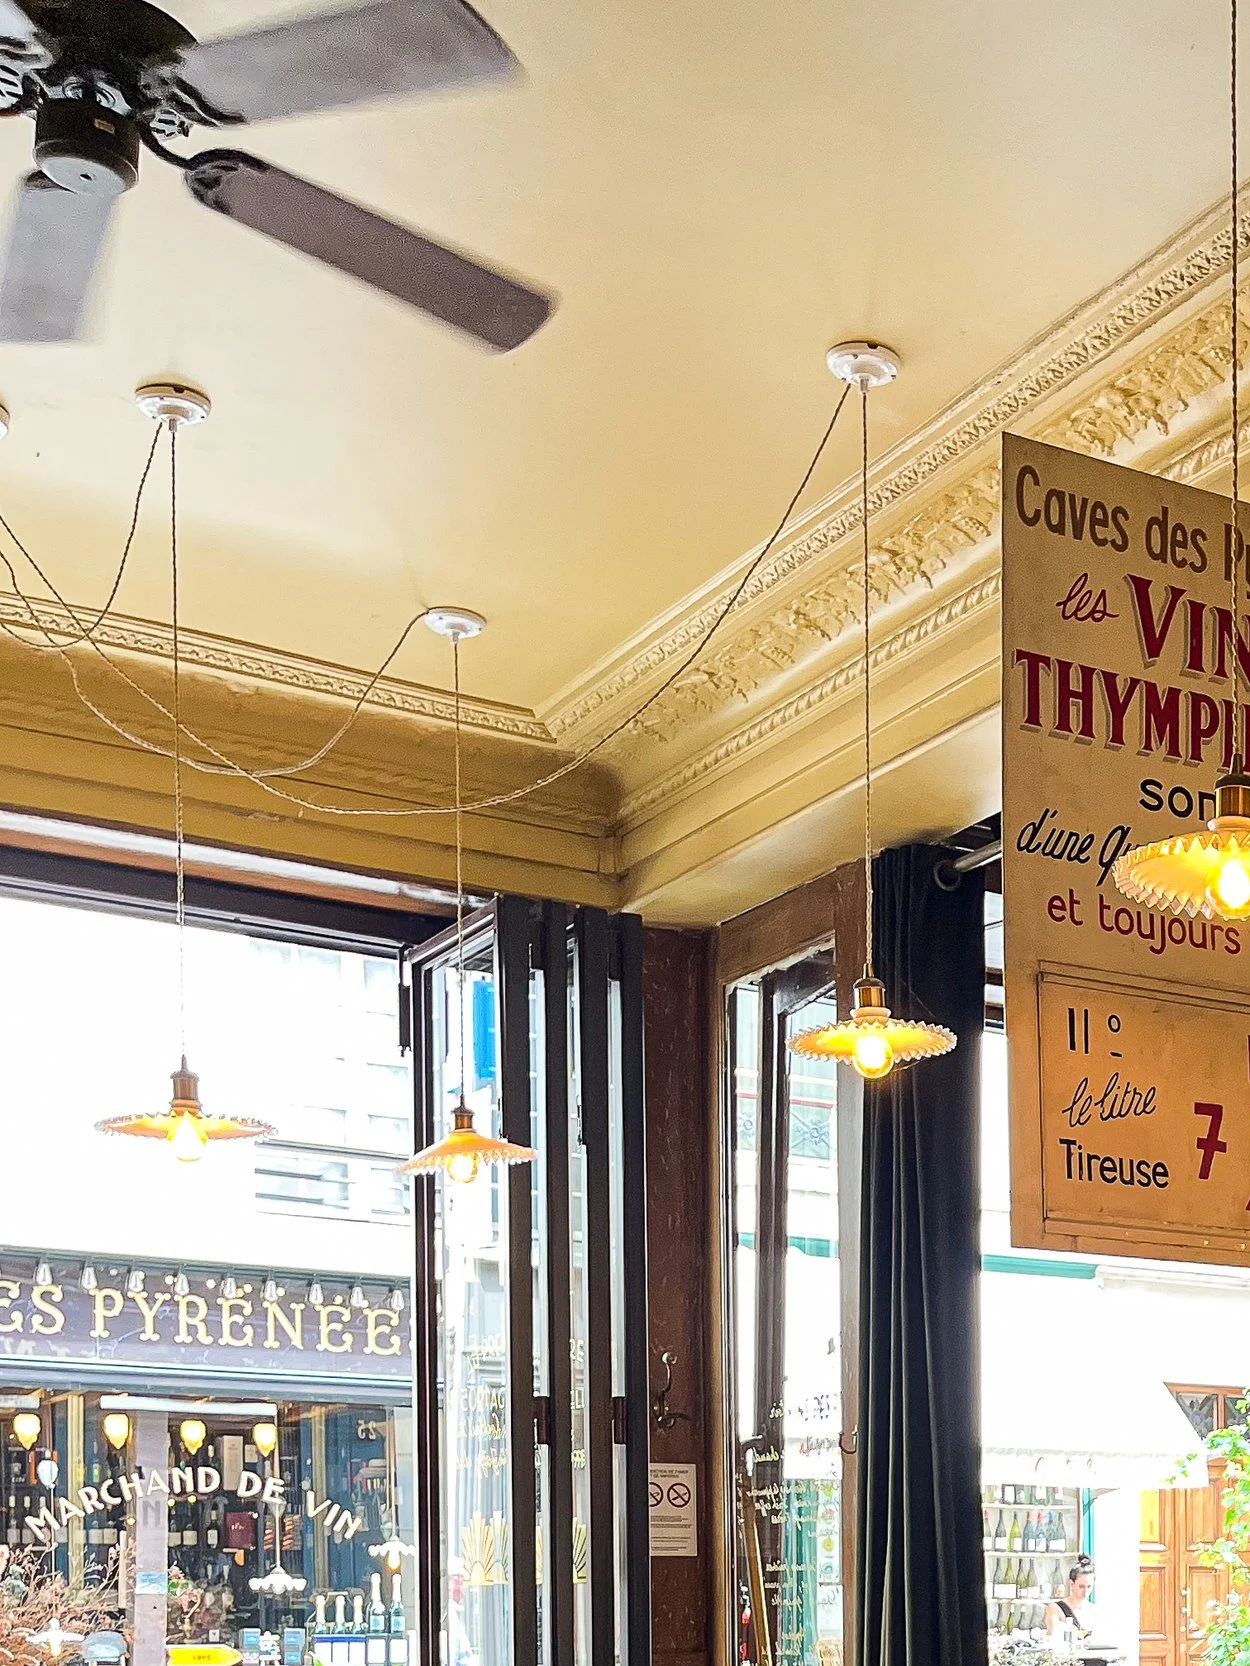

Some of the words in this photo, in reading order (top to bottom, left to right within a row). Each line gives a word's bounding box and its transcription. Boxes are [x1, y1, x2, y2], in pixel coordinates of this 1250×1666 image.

[1016, 465, 1129, 552] Caves
[1146, 506, 1208, 573] des
[1056, 572, 1119, 623] les
[1139, 778, 1217, 821] son
[1016, 808, 1095, 864] d'une
[1048, 888, 1083, 926] et
[1098, 894, 1241, 954] toujours
[1061, 1077, 1093, 1127] le
[1095, 1072, 1157, 1122] litre
[1059, 1138, 1169, 1189] Tireuse
[25, 1466, 221, 1541] MARCHAND
[236, 1470, 286, 1502] DE
[304, 1490, 362, 1540] VIN
